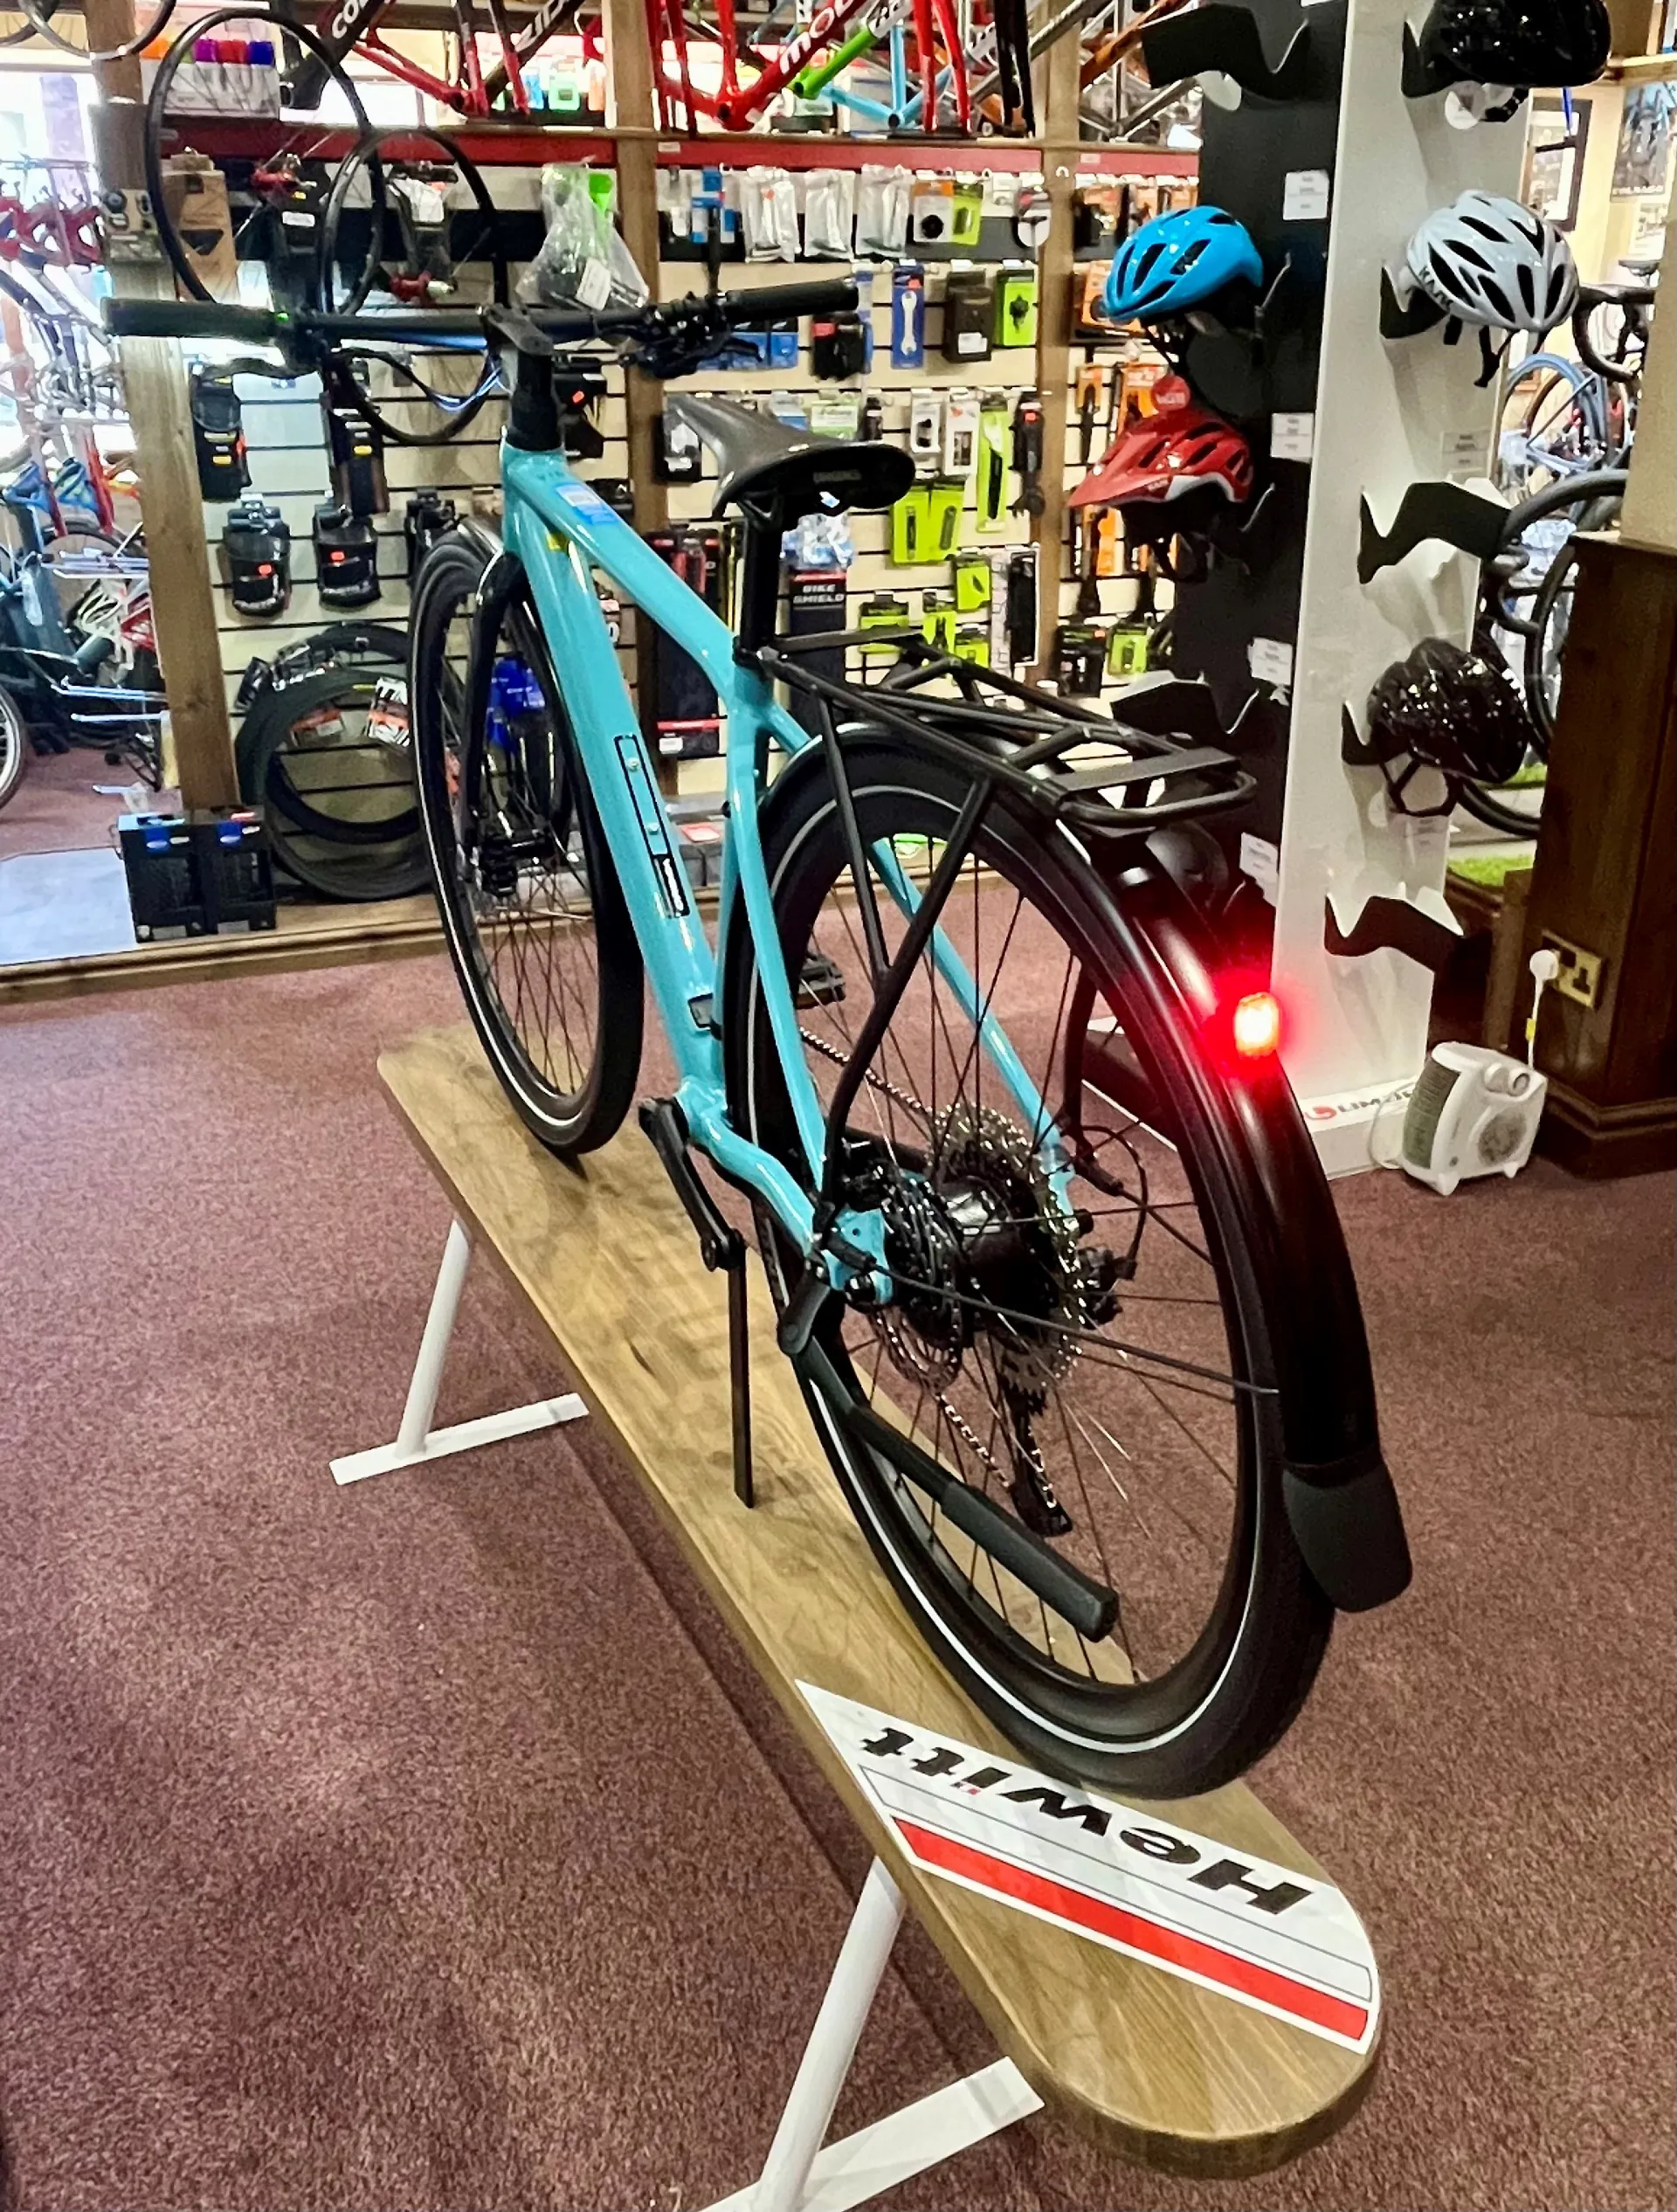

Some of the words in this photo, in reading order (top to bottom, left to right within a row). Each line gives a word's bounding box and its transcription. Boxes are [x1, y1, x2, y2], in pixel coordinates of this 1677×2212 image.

[803, 584, 836, 594] BIKE
[793, 593, 845, 604] SHIELD
[859, 1726, 1314, 1916] Hewitt
